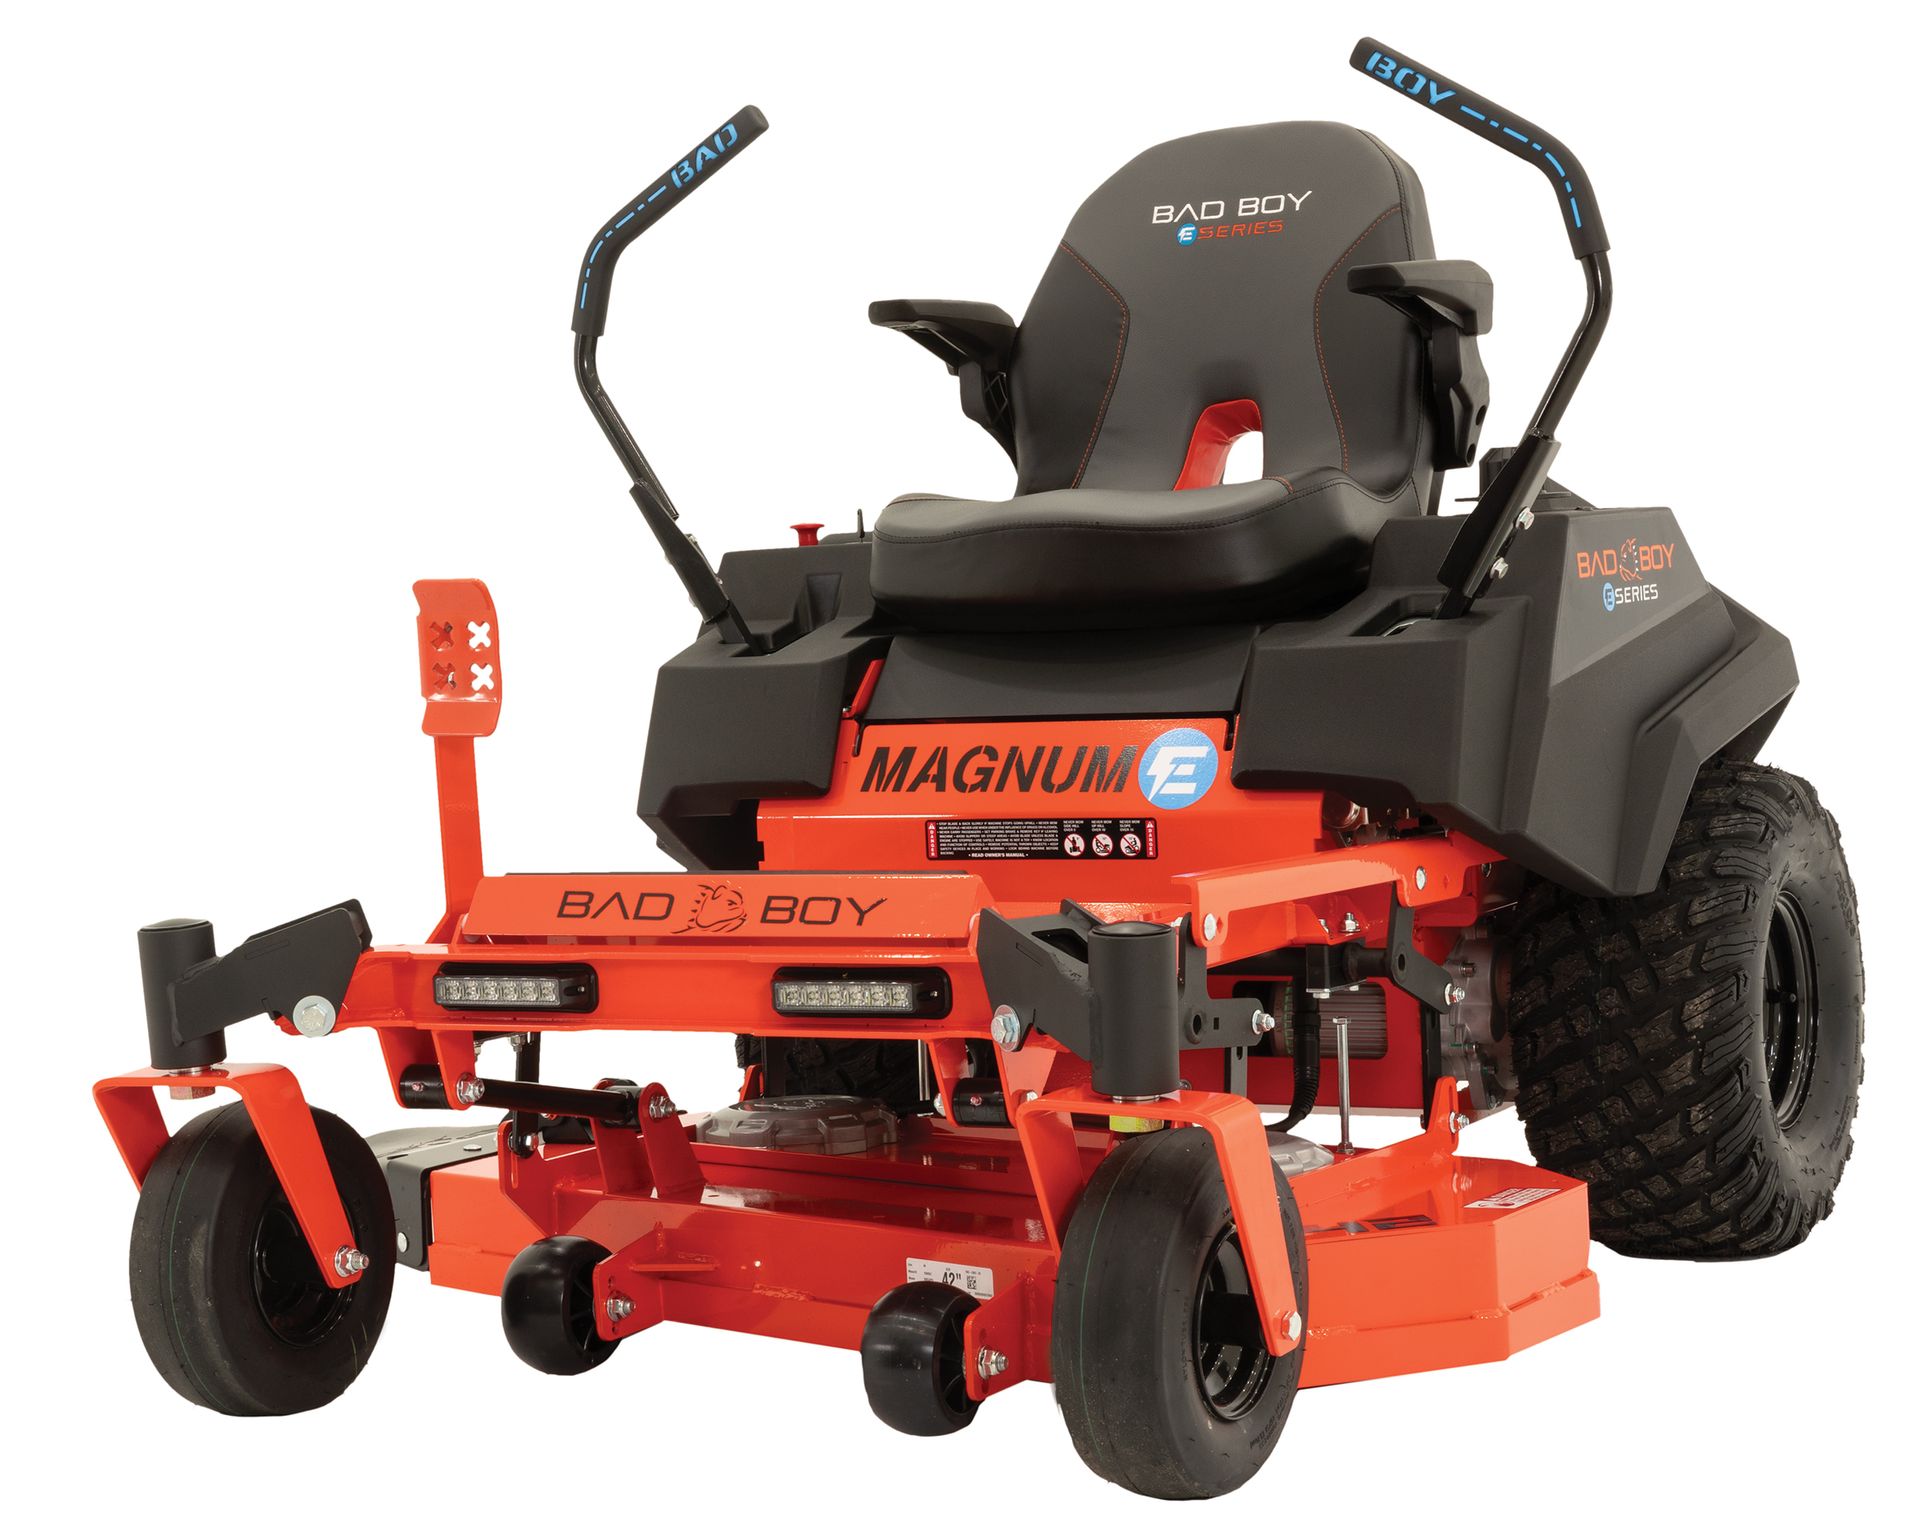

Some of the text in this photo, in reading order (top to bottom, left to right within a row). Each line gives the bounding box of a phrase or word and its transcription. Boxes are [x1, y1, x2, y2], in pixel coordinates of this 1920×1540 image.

[1365, 52, 1456, 105] BOY
[671, 123, 738, 188] BAD
[1151, 190, 1313, 228] BAD BOY
[1198, 219, 1284, 240] SERIES
[1576, 543, 1675, 580] BAD BOY
[1615, 583, 1659, 606] SERIES
[860, 745, 1138, 794] MAGNUM
[556, 890, 888, 926] BAD BOY
[941, 1271, 962, 1287] 42"
